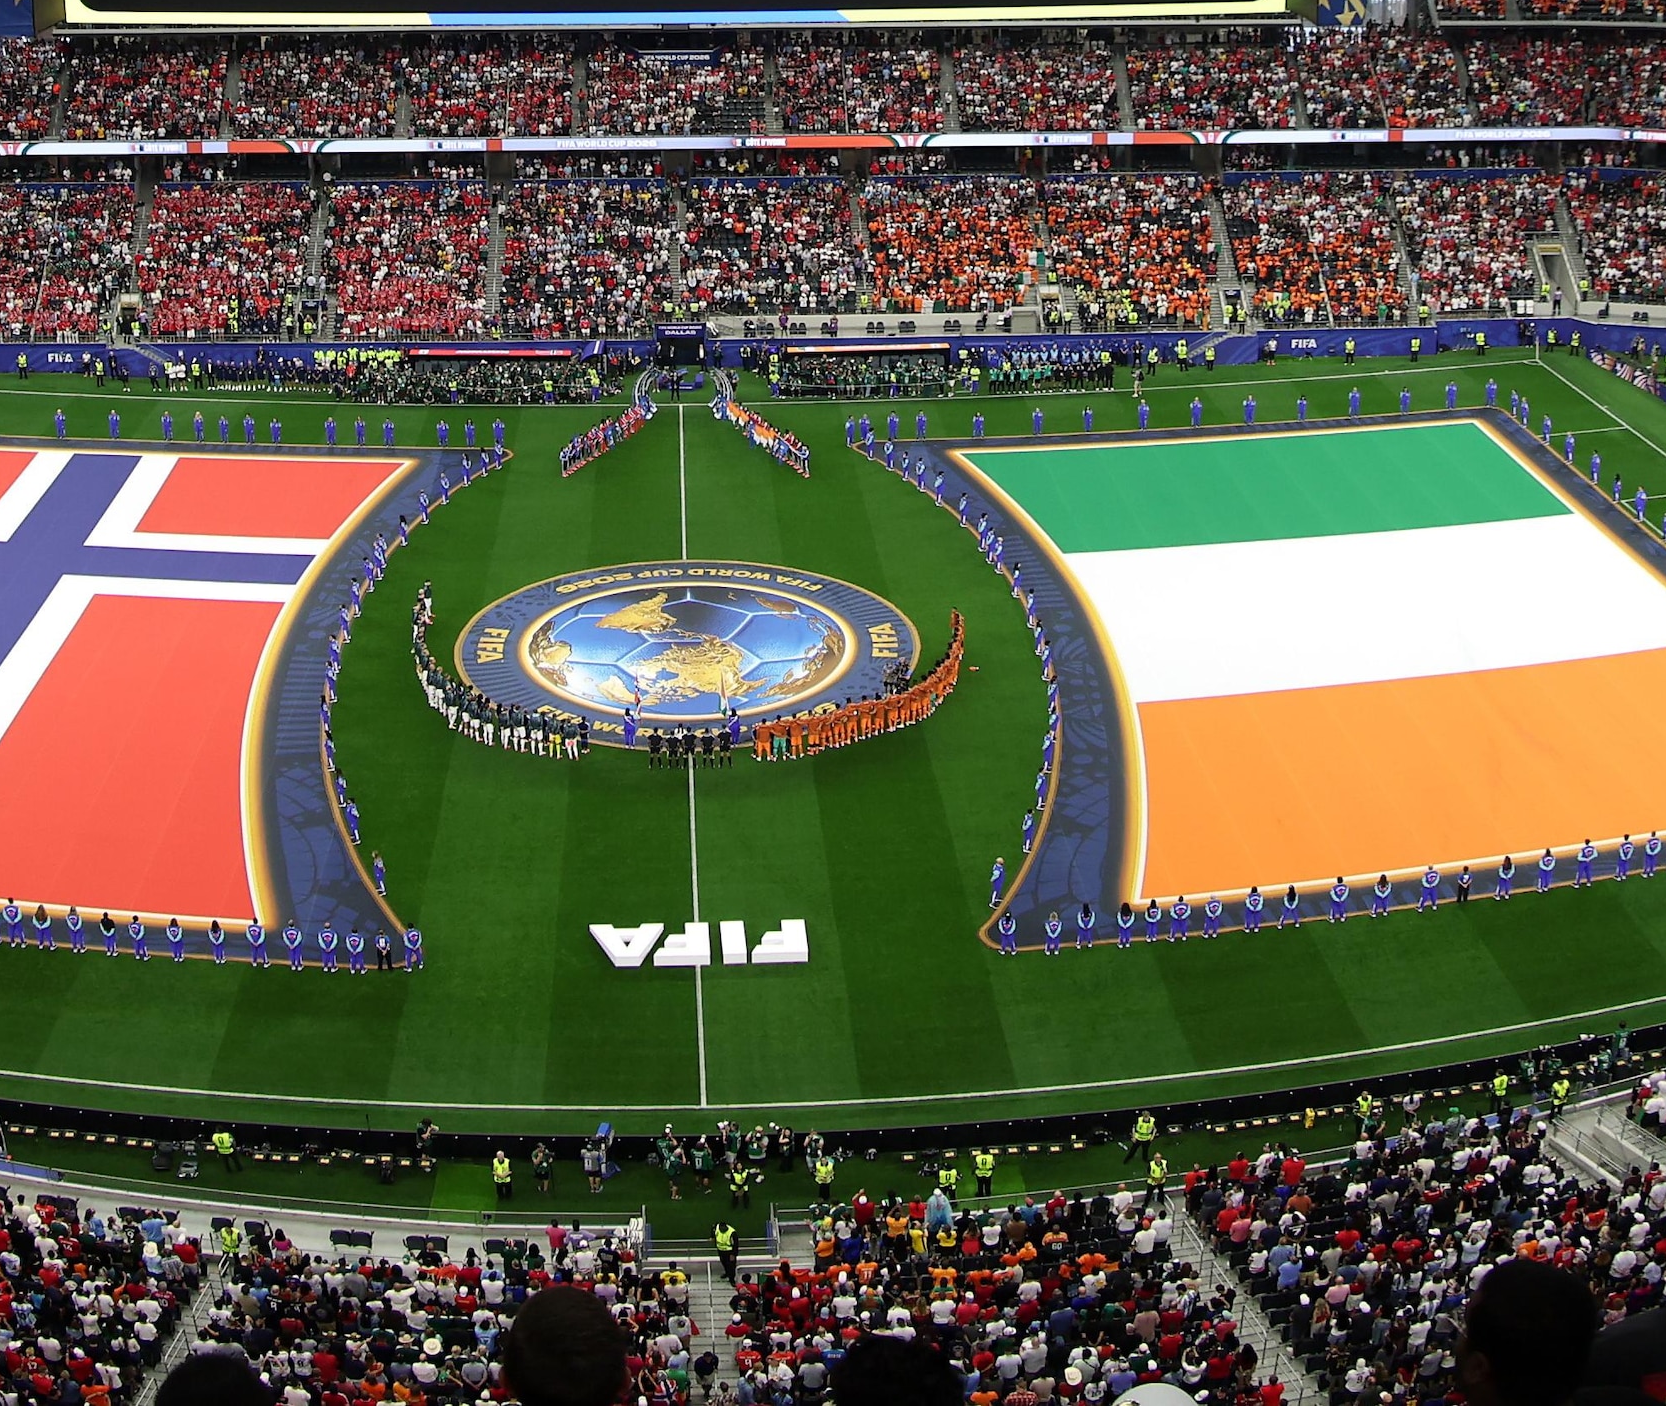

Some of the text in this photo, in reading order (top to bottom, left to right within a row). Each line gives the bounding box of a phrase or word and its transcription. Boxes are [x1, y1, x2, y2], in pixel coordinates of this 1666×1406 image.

[1455, 129, 1551, 139] FIFA WORLD CUP 2026
[556, 139, 657, 149] FIFA WORLD CUP 2026
[745, 137, 786, 147] CÔTE D'IVOIRE
[1290, 338, 1318, 349] FIFA
[47, 352, 74, 363] FIFA
[555, 568, 823, 595] FIFA WORLD CUP 2026
[476, 627, 510, 664] FIFA
[868, 623, 899, 658] FIFA
[588, 918, 808, 968] FIFA
